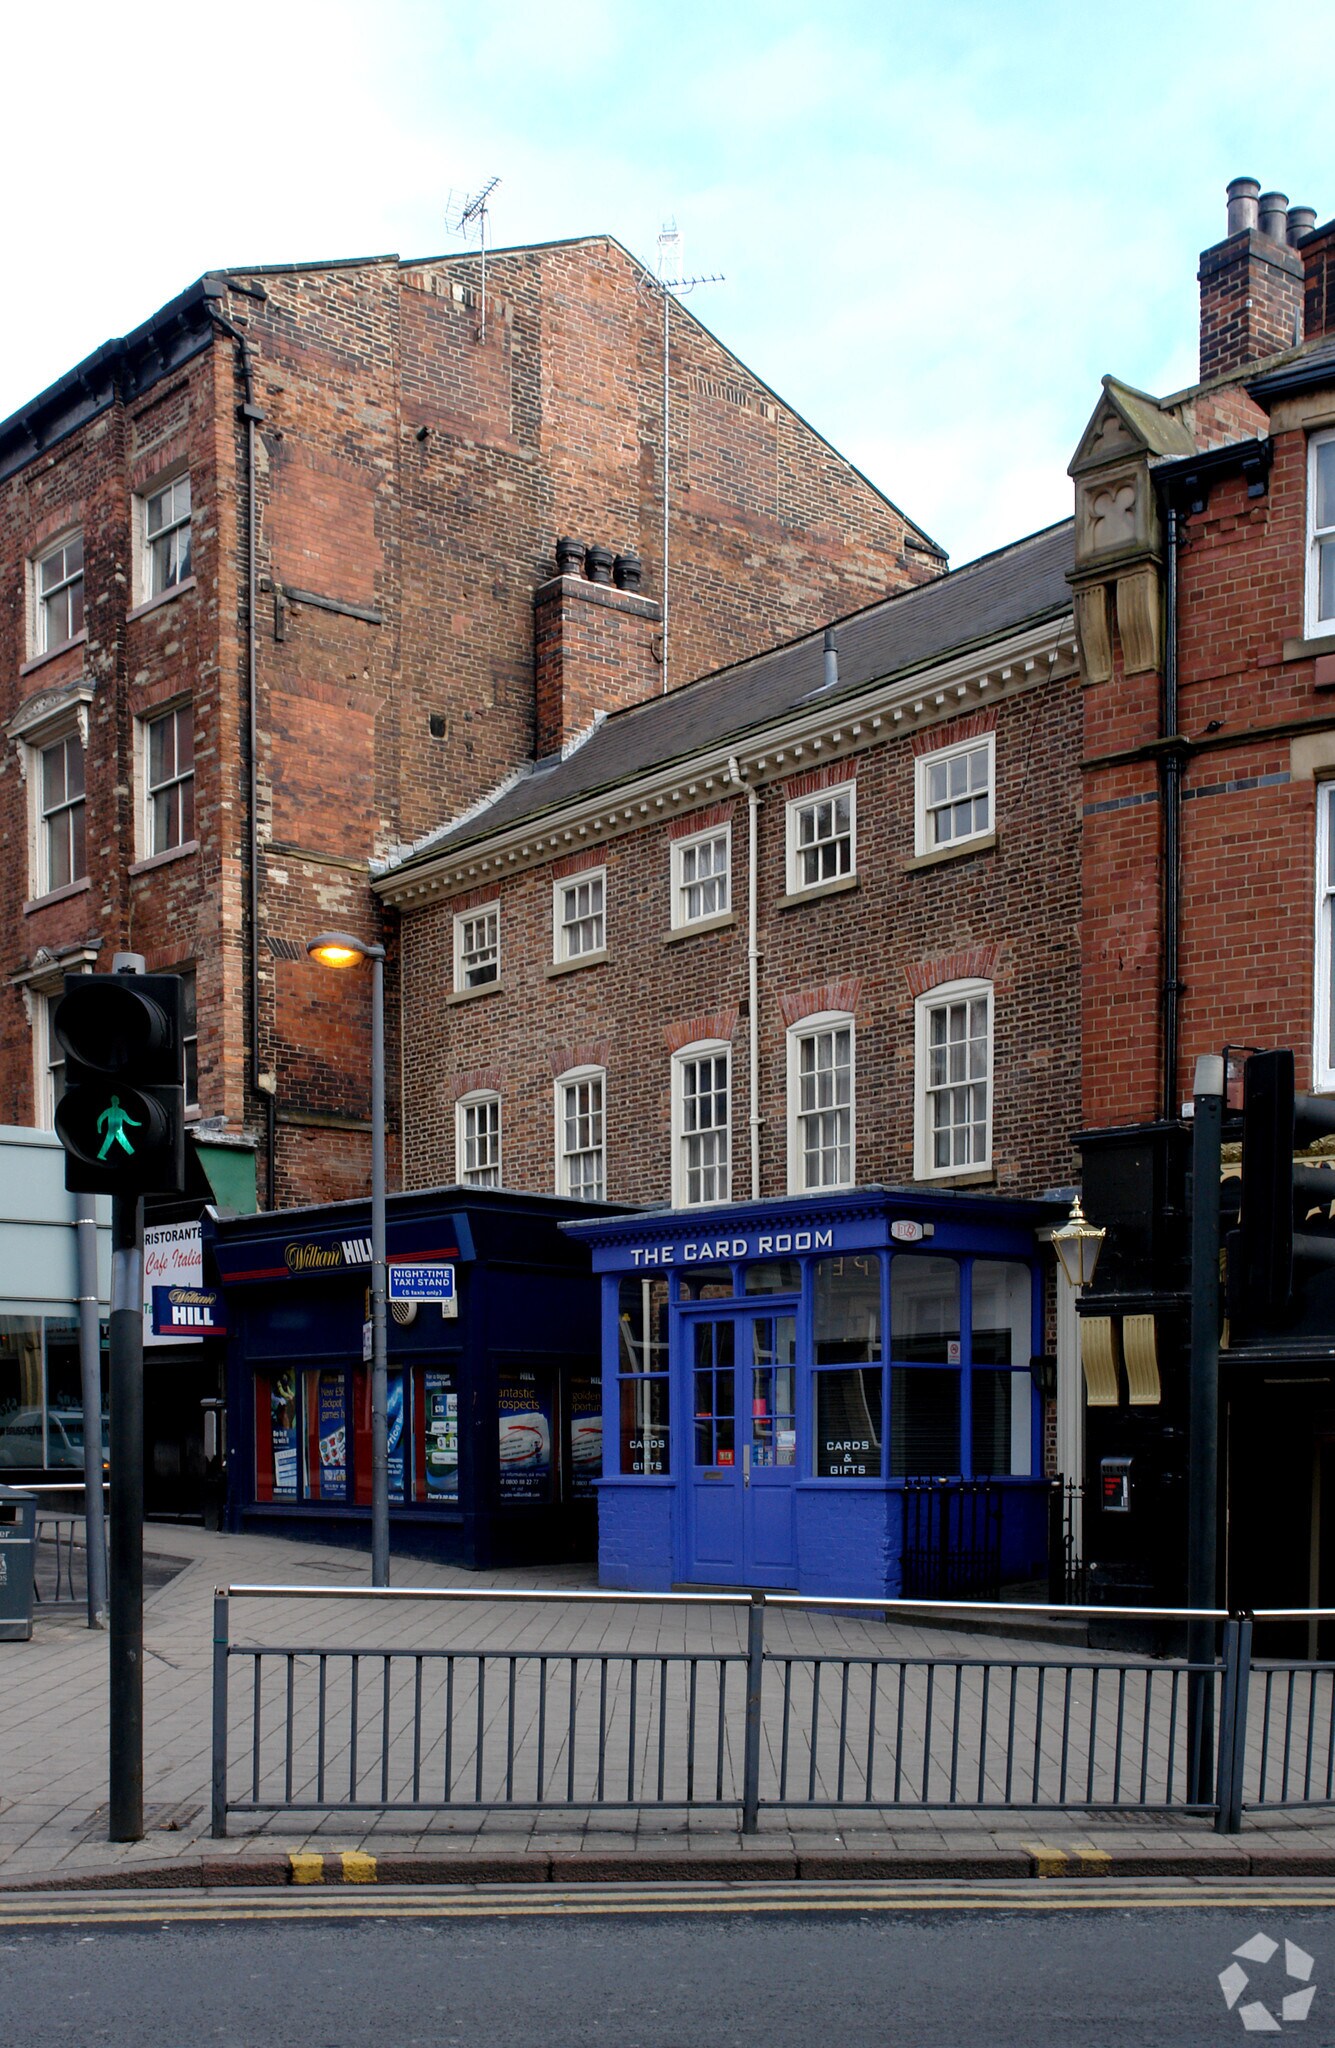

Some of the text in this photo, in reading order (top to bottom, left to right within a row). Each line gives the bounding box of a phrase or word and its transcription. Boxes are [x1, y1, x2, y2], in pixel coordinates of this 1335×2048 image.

[144, 1227, 202, 1245] RISTORANTE
[631, 1228, 833, 1265] THE CARD ROOM
[285, 1242, 342, 1273] William
[393, 1270, 450, 1278] NIGHT-TIME
[393, 1278, 450, 1286] TAXI STAND
[168, 1288, 216, 1306] William
[171, 1306, 214, 1326] HILL
[498, 1387, 536, 1399] antastic
[498, 1400, 540, 1412] rospects
[629, 1440, 665, 1449] CARDS
[826, 1440, 870, 1451] CARDS
[843, 1454, 852, 1463] &
[632, 1461, 663, 1471] GIFTS
[830, 1465, 867, 1475] GIFTS
[0, 1530, 10, 1538] er
